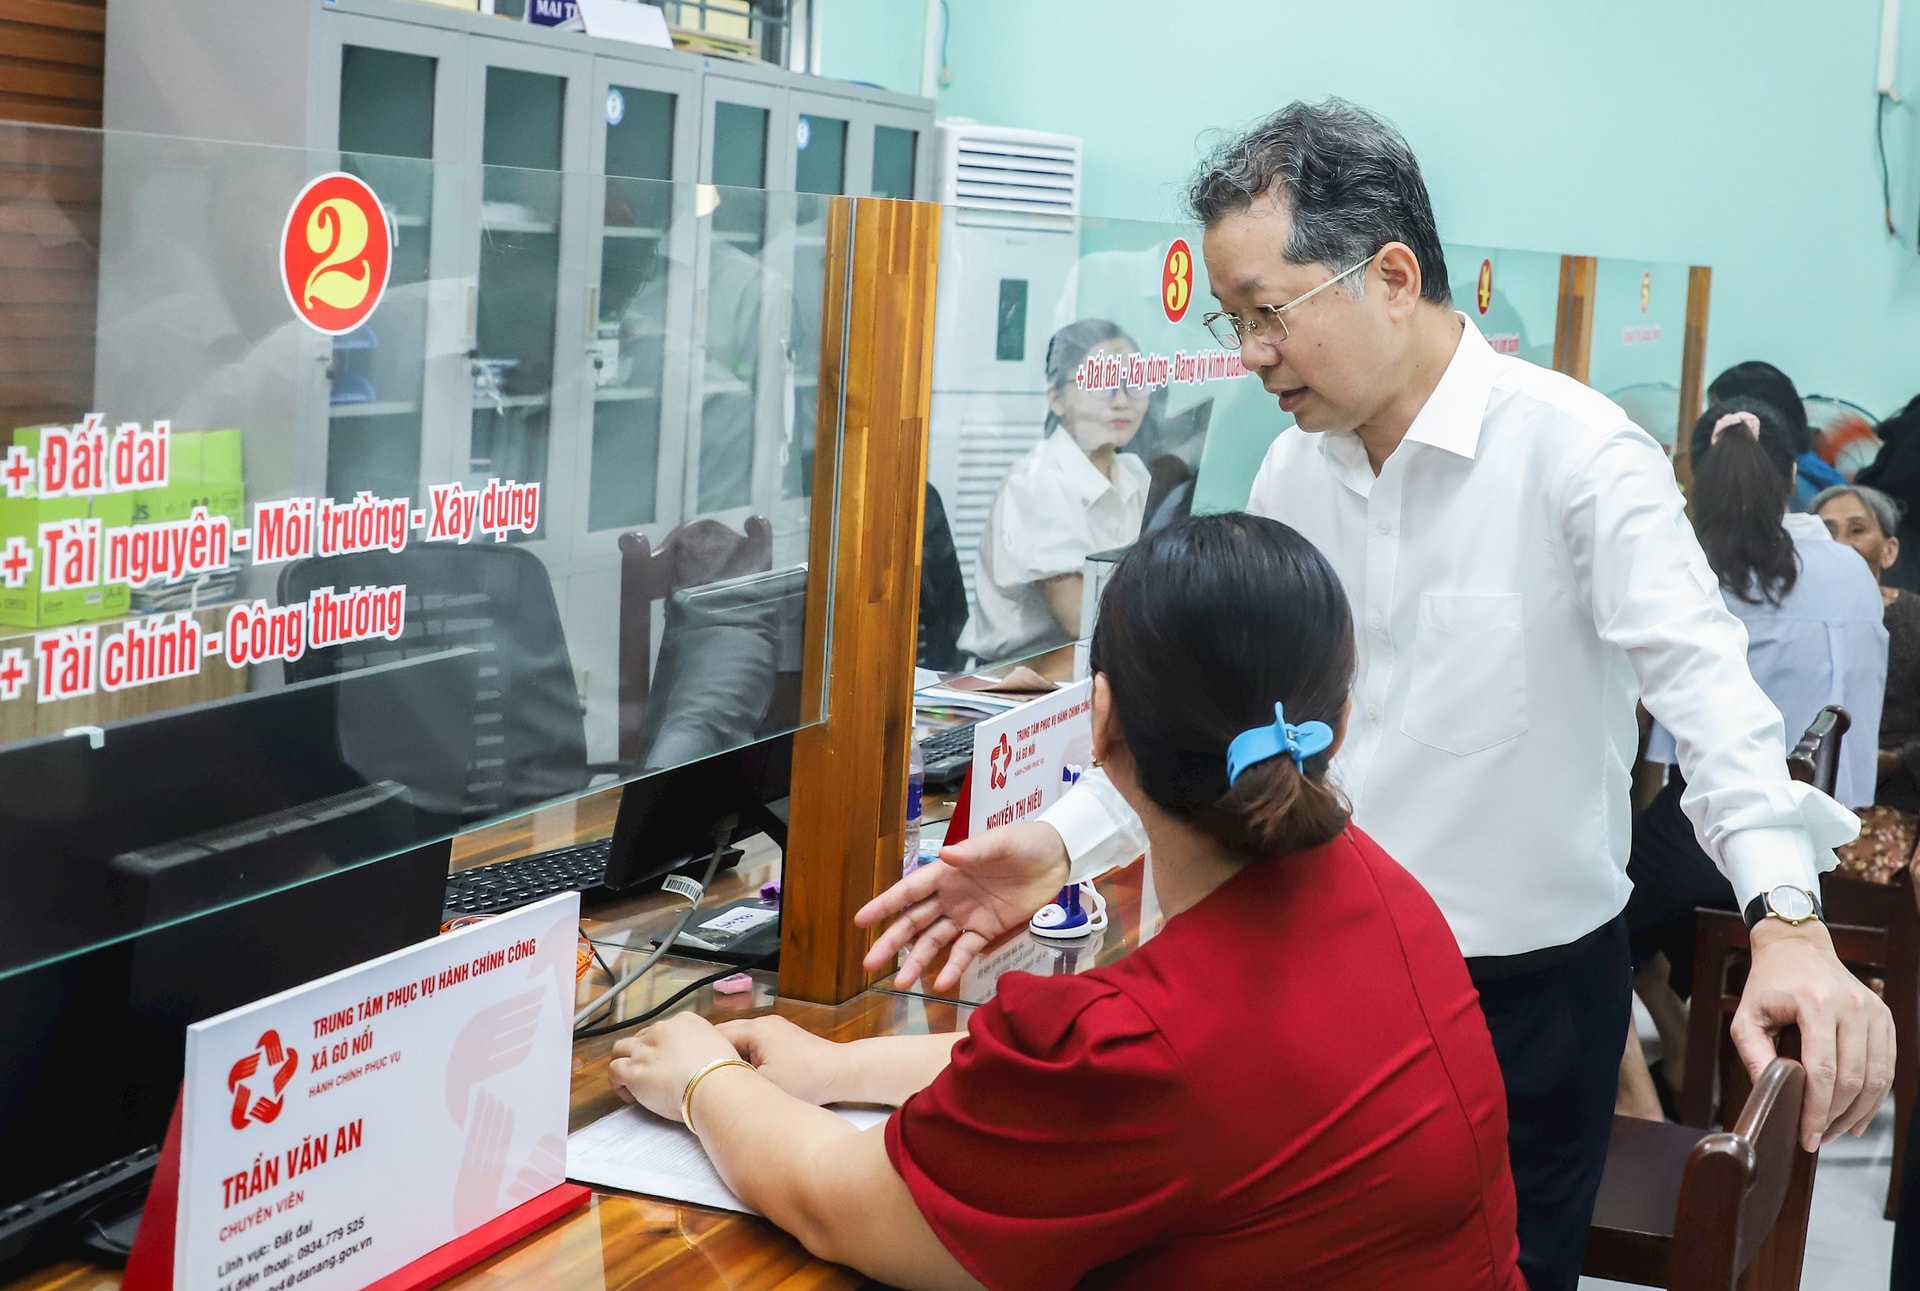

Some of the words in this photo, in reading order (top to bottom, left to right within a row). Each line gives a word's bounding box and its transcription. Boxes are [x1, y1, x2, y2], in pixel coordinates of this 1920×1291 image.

[303, 197, 371, 310] 2
[1166, 250, 1189, 312] 3
[1479, 264, 1491, 308] 4
[1086, 352, 1103, 390] Đất
[1105, 356, 1121, 387] đai
[1128, 354, 1145, 388] Xây
[1146, 354, 1168, 390] dựng
[44, 418, 104, 492] Đất
[115, 427, 165, 486] đai
[45, 524, 97, 587] Tài
[109, 512, 227, 584] nguyên
[257, 502, 312, 561] Môi
[321, 494, 407, 551] trường
[432, 486, 476, 540] Xây
[482, 482, 537, 539] dựng
[41, 631, 92, 697] Tài
[104, 619, 197, 687] chính
[230, 606, 302, 665] Công
[313, 589, 403, 645] thương
[313, 1007, 354, 1040] TRUNG
[358, 995, 384, 1020] TÂM
[386, 982, 418, 1009] PHỤC
[421, 975, 436, 999] VỤ
[438, 963, 469, 991] HÀNH
[472, 949, 505, 977] CHÍNH
[507, 938, 537, 965] CÔNG
[308, 1078, 334, 1099] HÀNH
[335, 1067, 362, 1088] CHÍNH
[364, 1055, 388, 1075] PHỤC
[389, 1049, 402, 1066] VỤ
[311, 1045, 328, 1074] XÃ
[332, 1036, 348, 1065] GÒ
[286, 1134, 328, 1180] VĂN
[334, 1118, 363, 1159] AN
[218, 1205, 273, 1243] CHUYÊN
[276, 1190, 305, 1215] VIÊN
[274, 1229, 293, 1250] Đất
[295, 1219, 313, 1239] đai
[346, 1216, 366, 1236] 525
